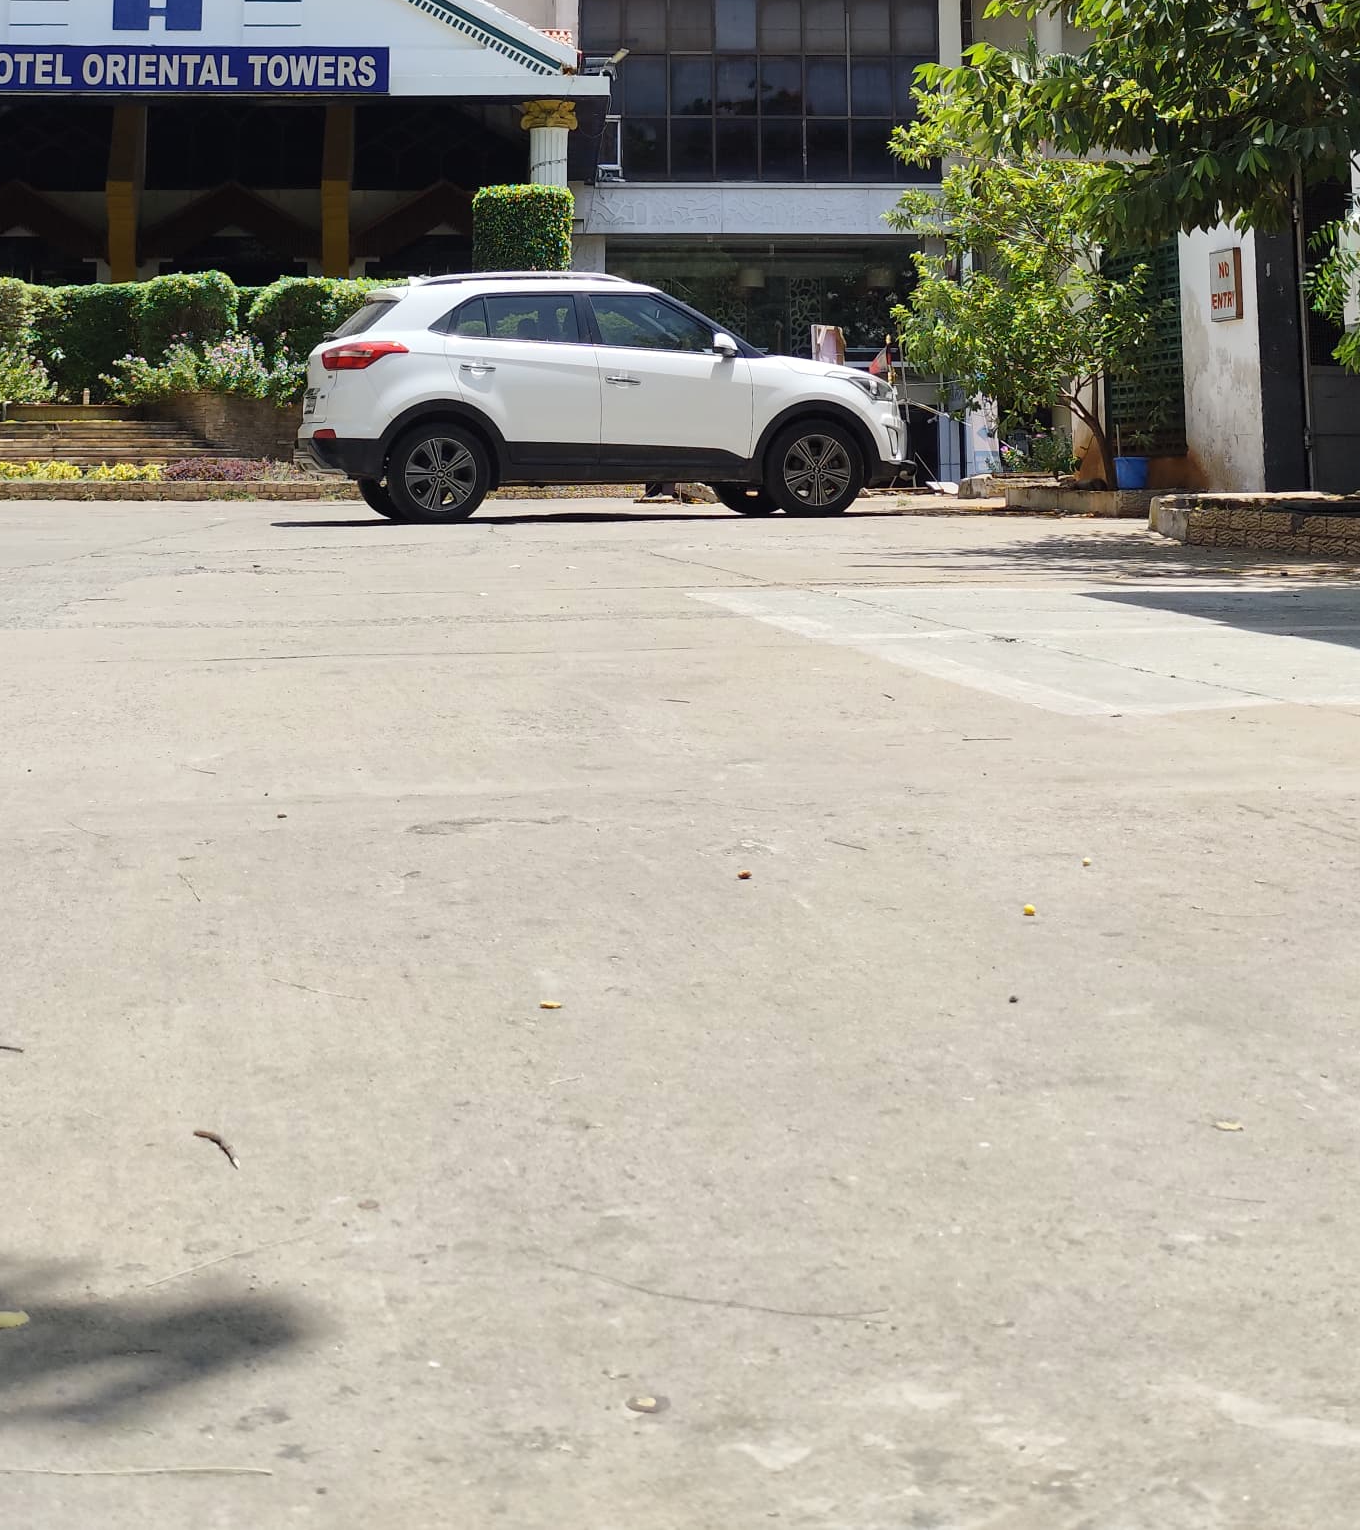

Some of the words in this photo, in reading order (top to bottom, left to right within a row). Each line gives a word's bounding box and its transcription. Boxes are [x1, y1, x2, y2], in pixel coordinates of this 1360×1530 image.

[82, 54, 238, 86] ORIENTAL
[248, 55, 377, 87] TOWERS
[1218, 262, 1230, 278] NO
